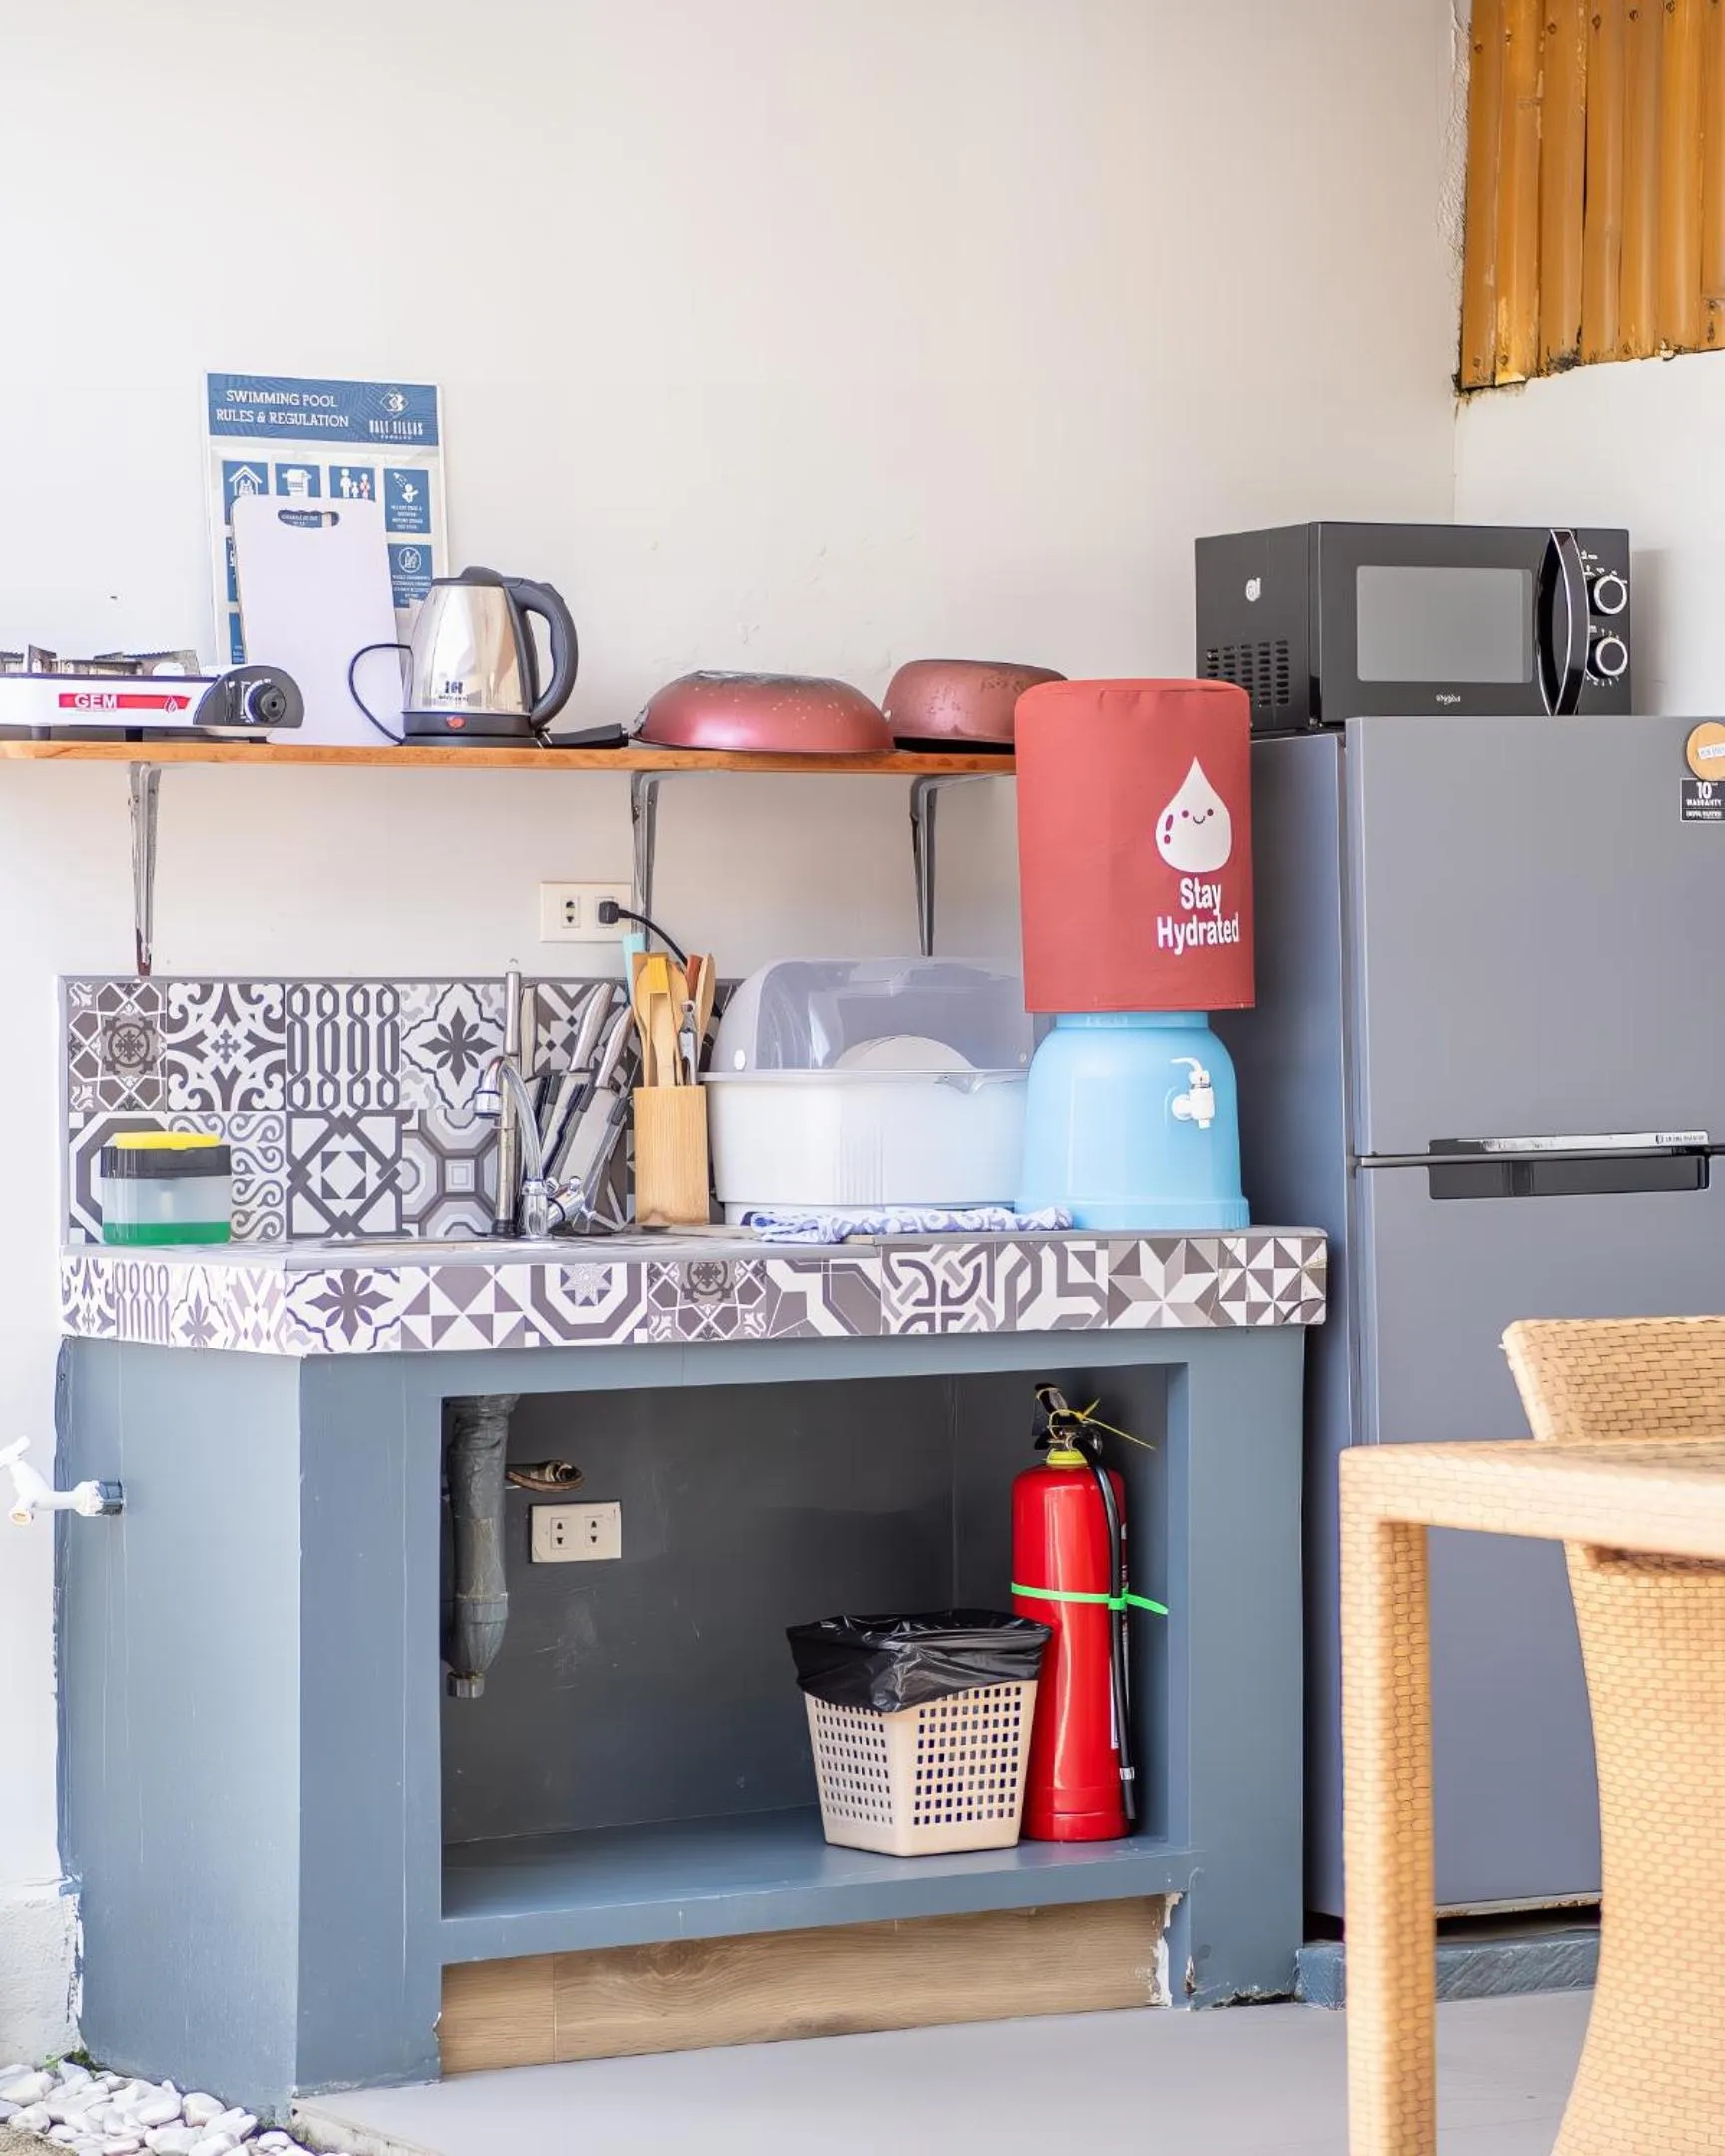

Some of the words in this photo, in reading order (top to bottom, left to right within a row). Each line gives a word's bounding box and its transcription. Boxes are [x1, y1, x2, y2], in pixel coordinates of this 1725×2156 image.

[226, 390, 300, 406] SWIMMING
[302, 394, 339, 408] POOL
[216, 408, 254, 422] RULES
[256, 411, 266, 424] &
[268, 411, 349, 427] REGULATION
[74, 694, 117, 708] GEM
[1696, 781, 1712, 799] 10
[1180, 877, 1221, 916] Stay
[1157, 912, 1240, 955] Hydrated
